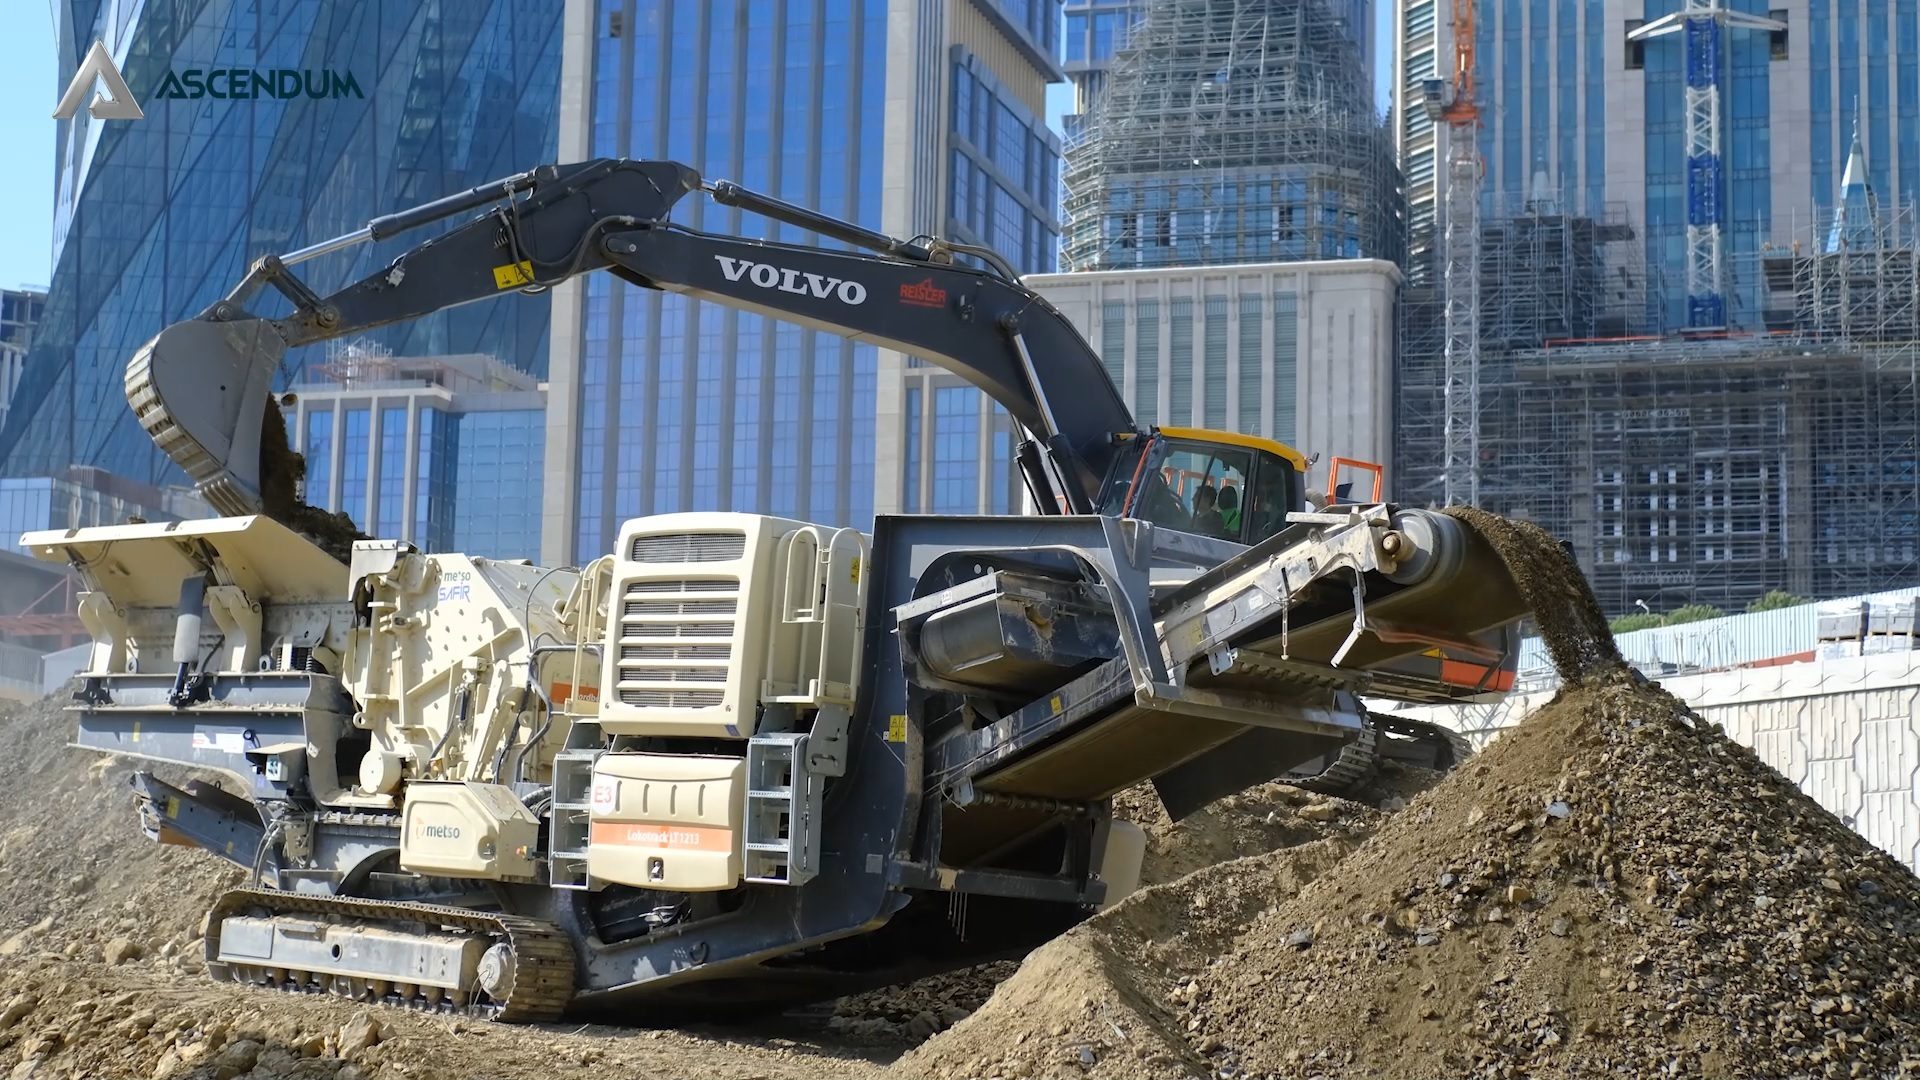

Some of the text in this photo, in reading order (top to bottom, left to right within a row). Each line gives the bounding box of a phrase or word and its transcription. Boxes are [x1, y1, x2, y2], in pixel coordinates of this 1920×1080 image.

[714, 254, 867, 305] VOLVO
[900, 283, 946, 304] REISLER
[594, 785, 612, 803] E3
[427, 825, 460, 838] metso
[627, 829, 668, 843] Lokotrack
